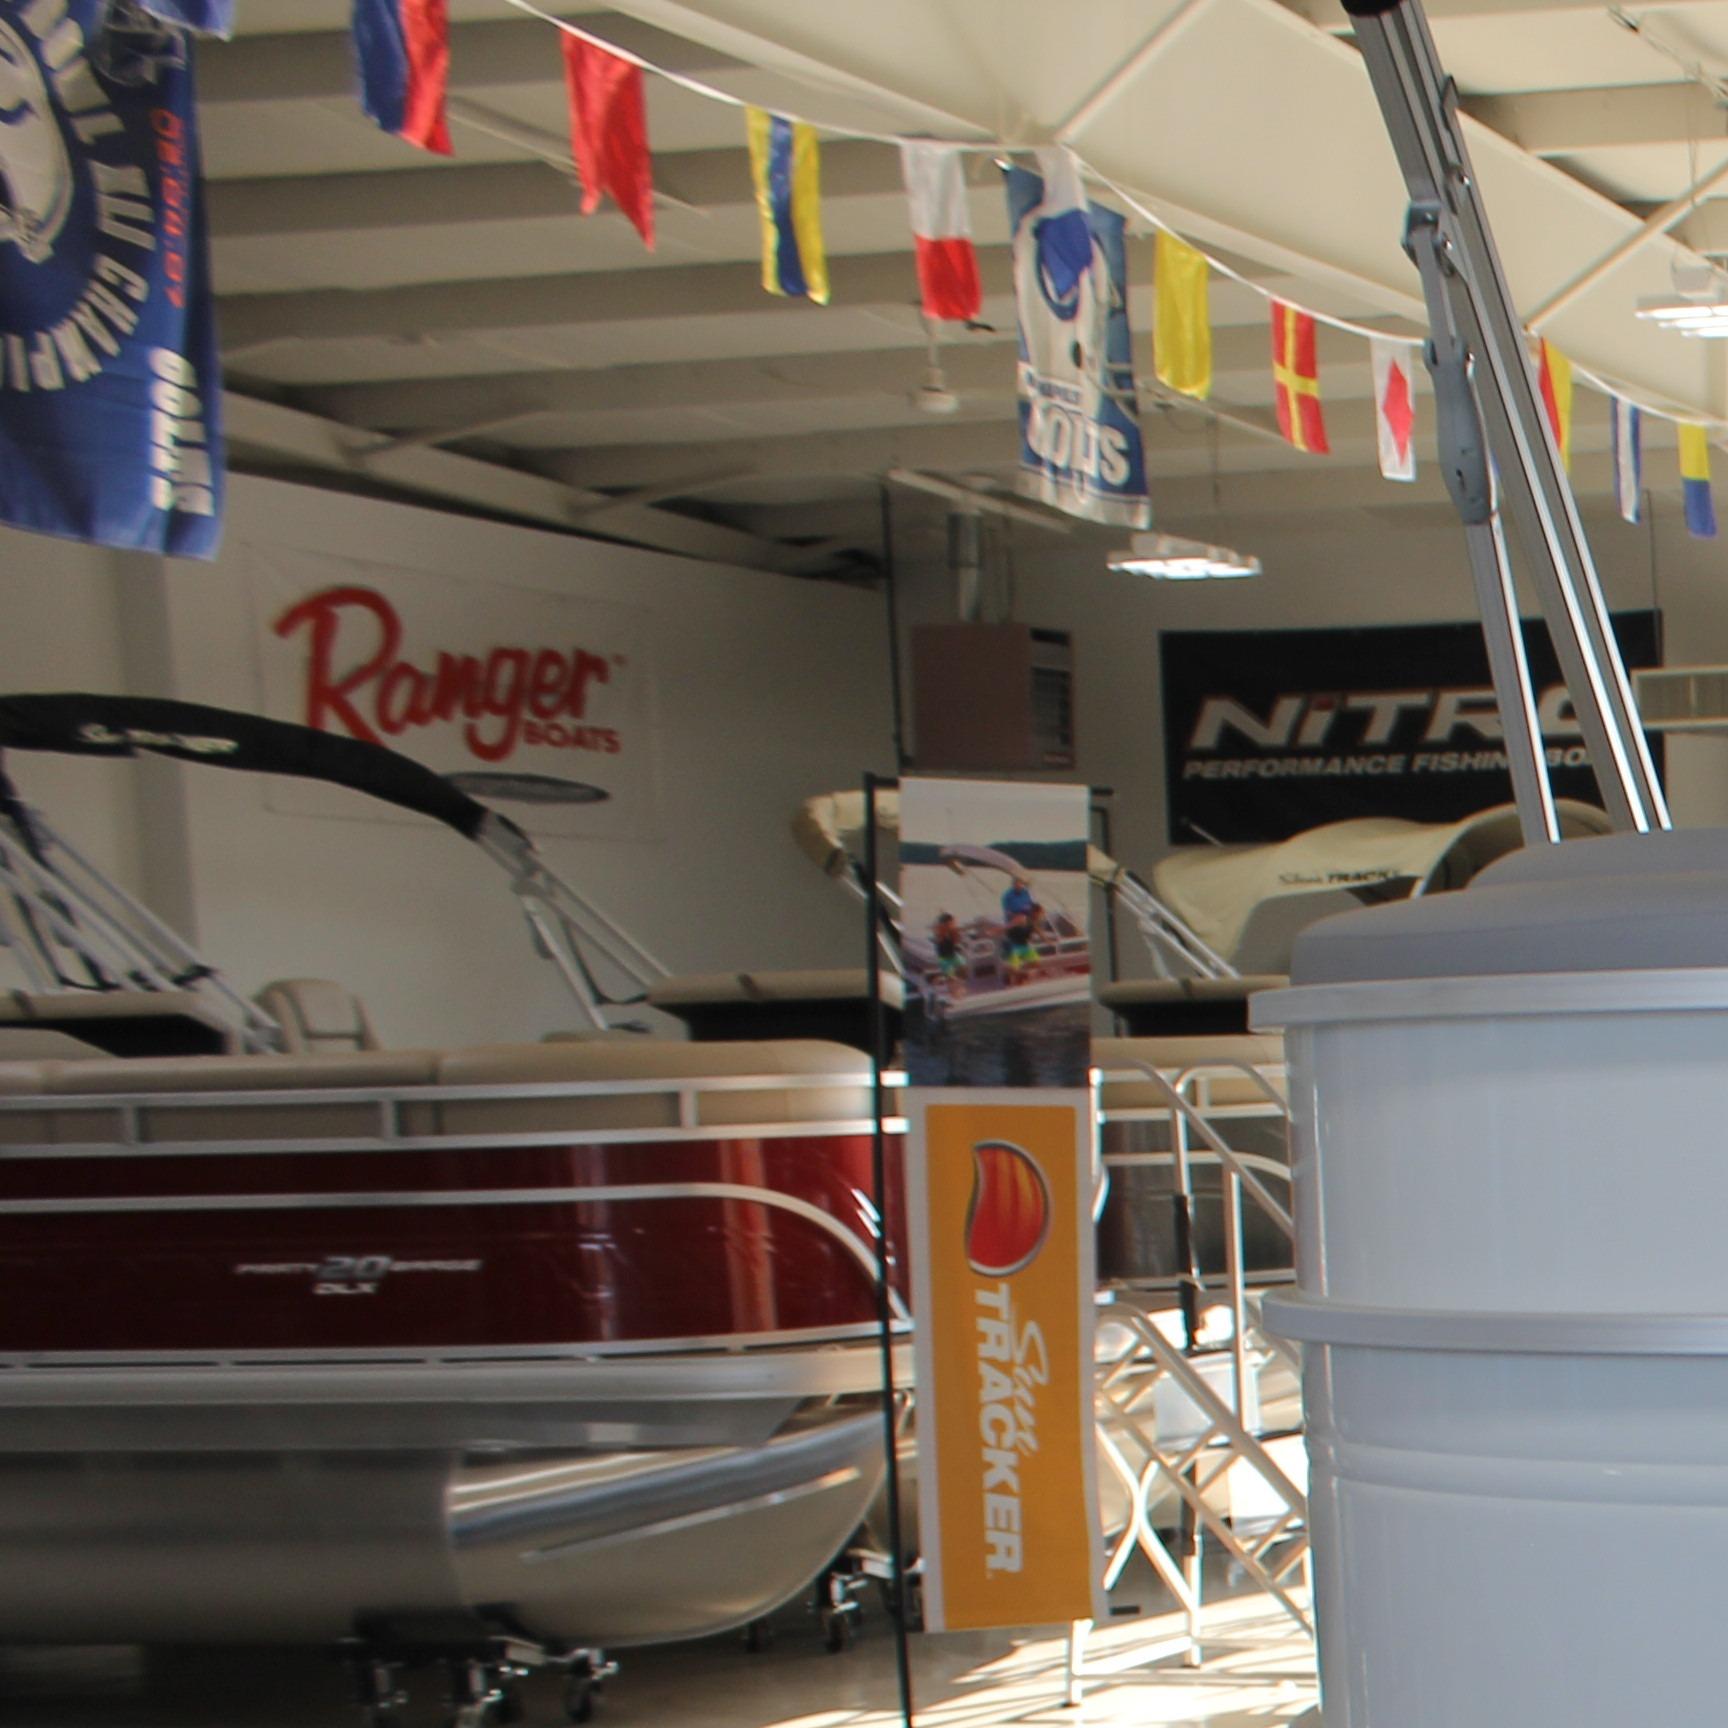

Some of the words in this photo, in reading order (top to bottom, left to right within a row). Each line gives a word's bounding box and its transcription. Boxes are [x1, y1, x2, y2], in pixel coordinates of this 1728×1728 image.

[269, 585, 610, 762] Ranger
[522, 718, 622, 754] BOATS
[1183, 752, 1407, 780] PERFORMANCE
[1411, 748, 1511, 773] FISHIN
[318, 1255, 393, 1280] 20
[975, 1282, 1024, 1574] TRACKER
